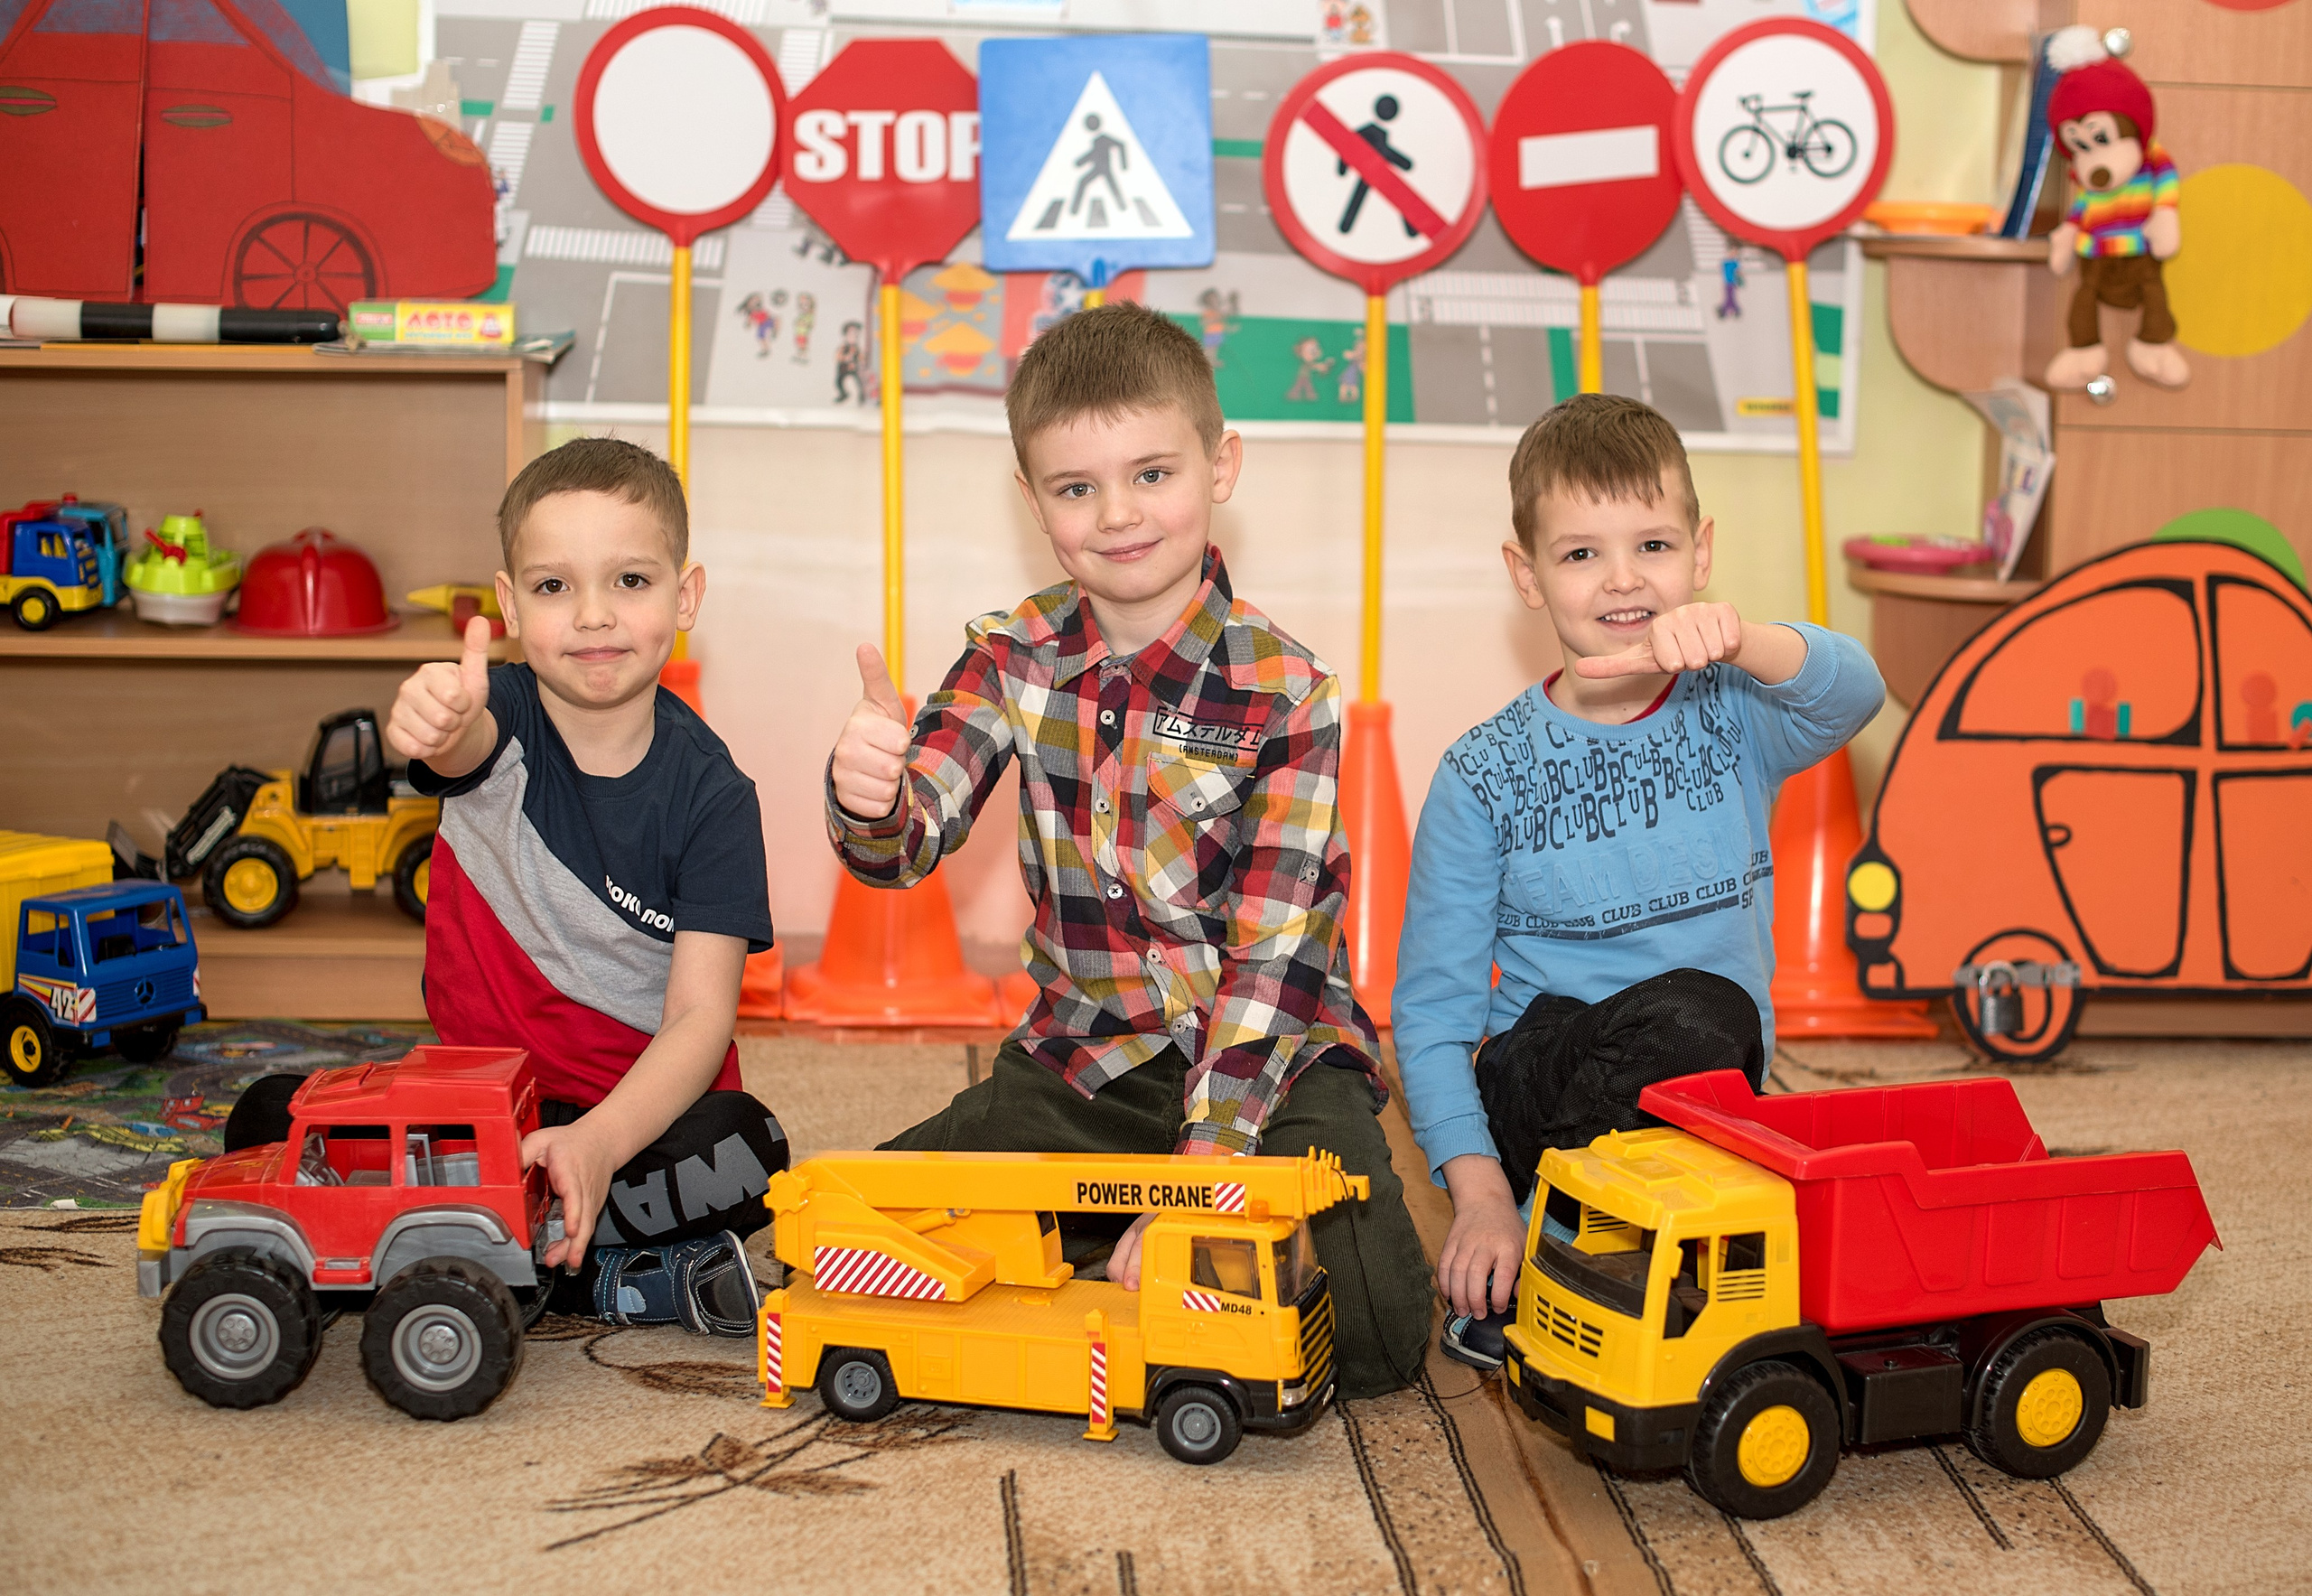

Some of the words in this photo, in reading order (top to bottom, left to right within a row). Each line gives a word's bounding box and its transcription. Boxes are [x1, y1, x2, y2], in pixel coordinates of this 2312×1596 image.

[793, 108, 982, 183] STOP
[1601, 903, 1642, 924] CLUB
[1648, 891, 1690, 912] CLUB
[1695, 877, 1738, 901] CLUB
[1077, 1182, 1142, 1206] POWER
[1149, 1184, 1213, 1208] CRANE
[1220, 1303, 1253, 1316] MD48
